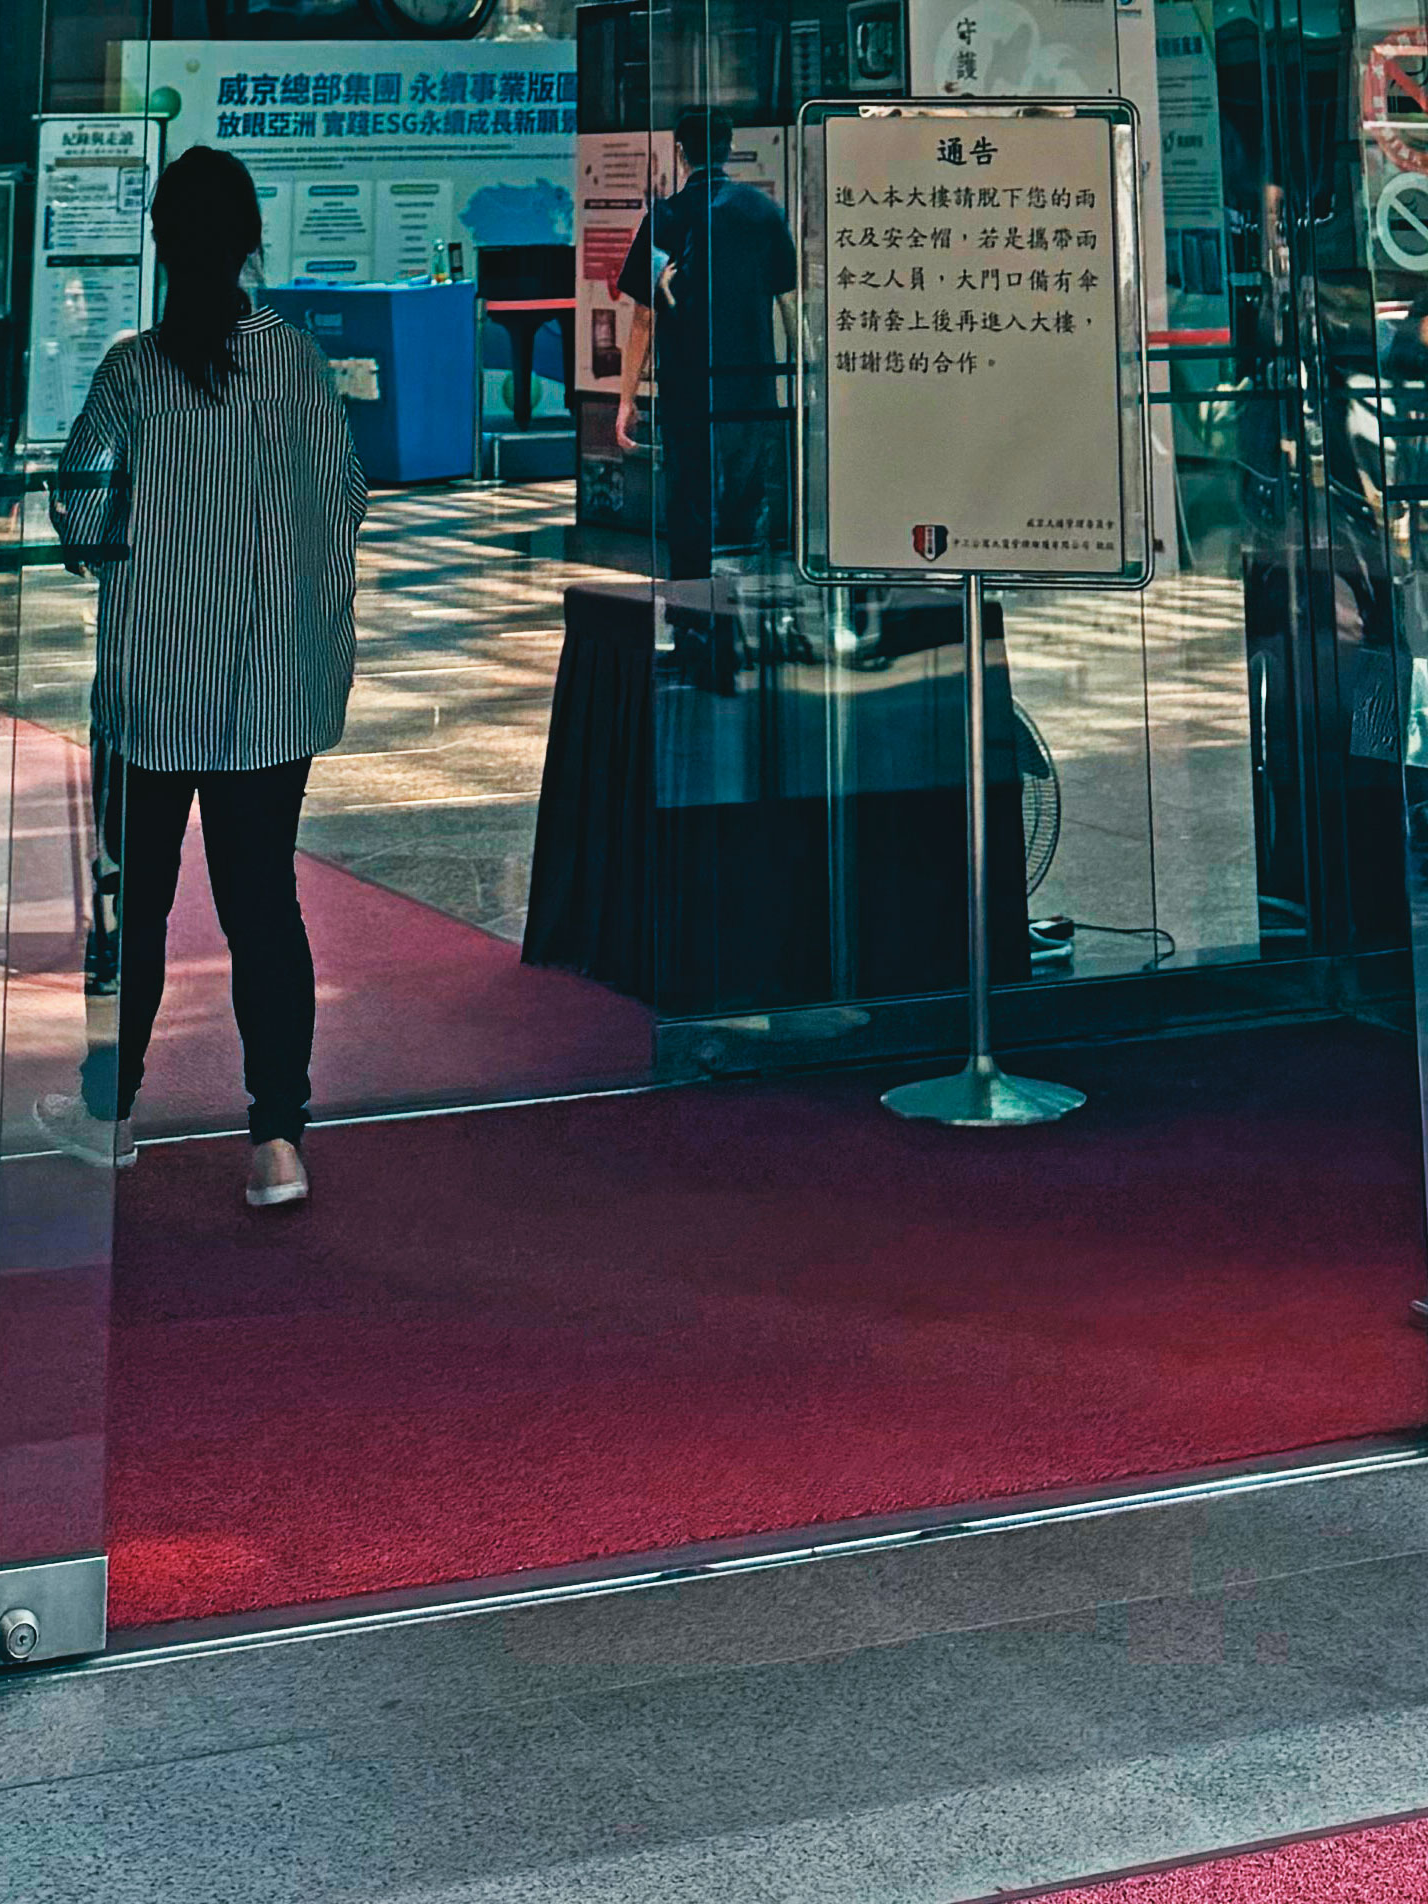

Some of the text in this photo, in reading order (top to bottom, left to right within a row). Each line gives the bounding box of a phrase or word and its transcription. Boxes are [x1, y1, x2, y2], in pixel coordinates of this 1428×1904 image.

[218, 72, 402, 106] 威京總部集團
[217, 110, 317, 138] 放眼亞洲
[936, 136, 999, 166] 通告
[834, 185, 1097, 210] 進入本大樓請脫下您的雨
